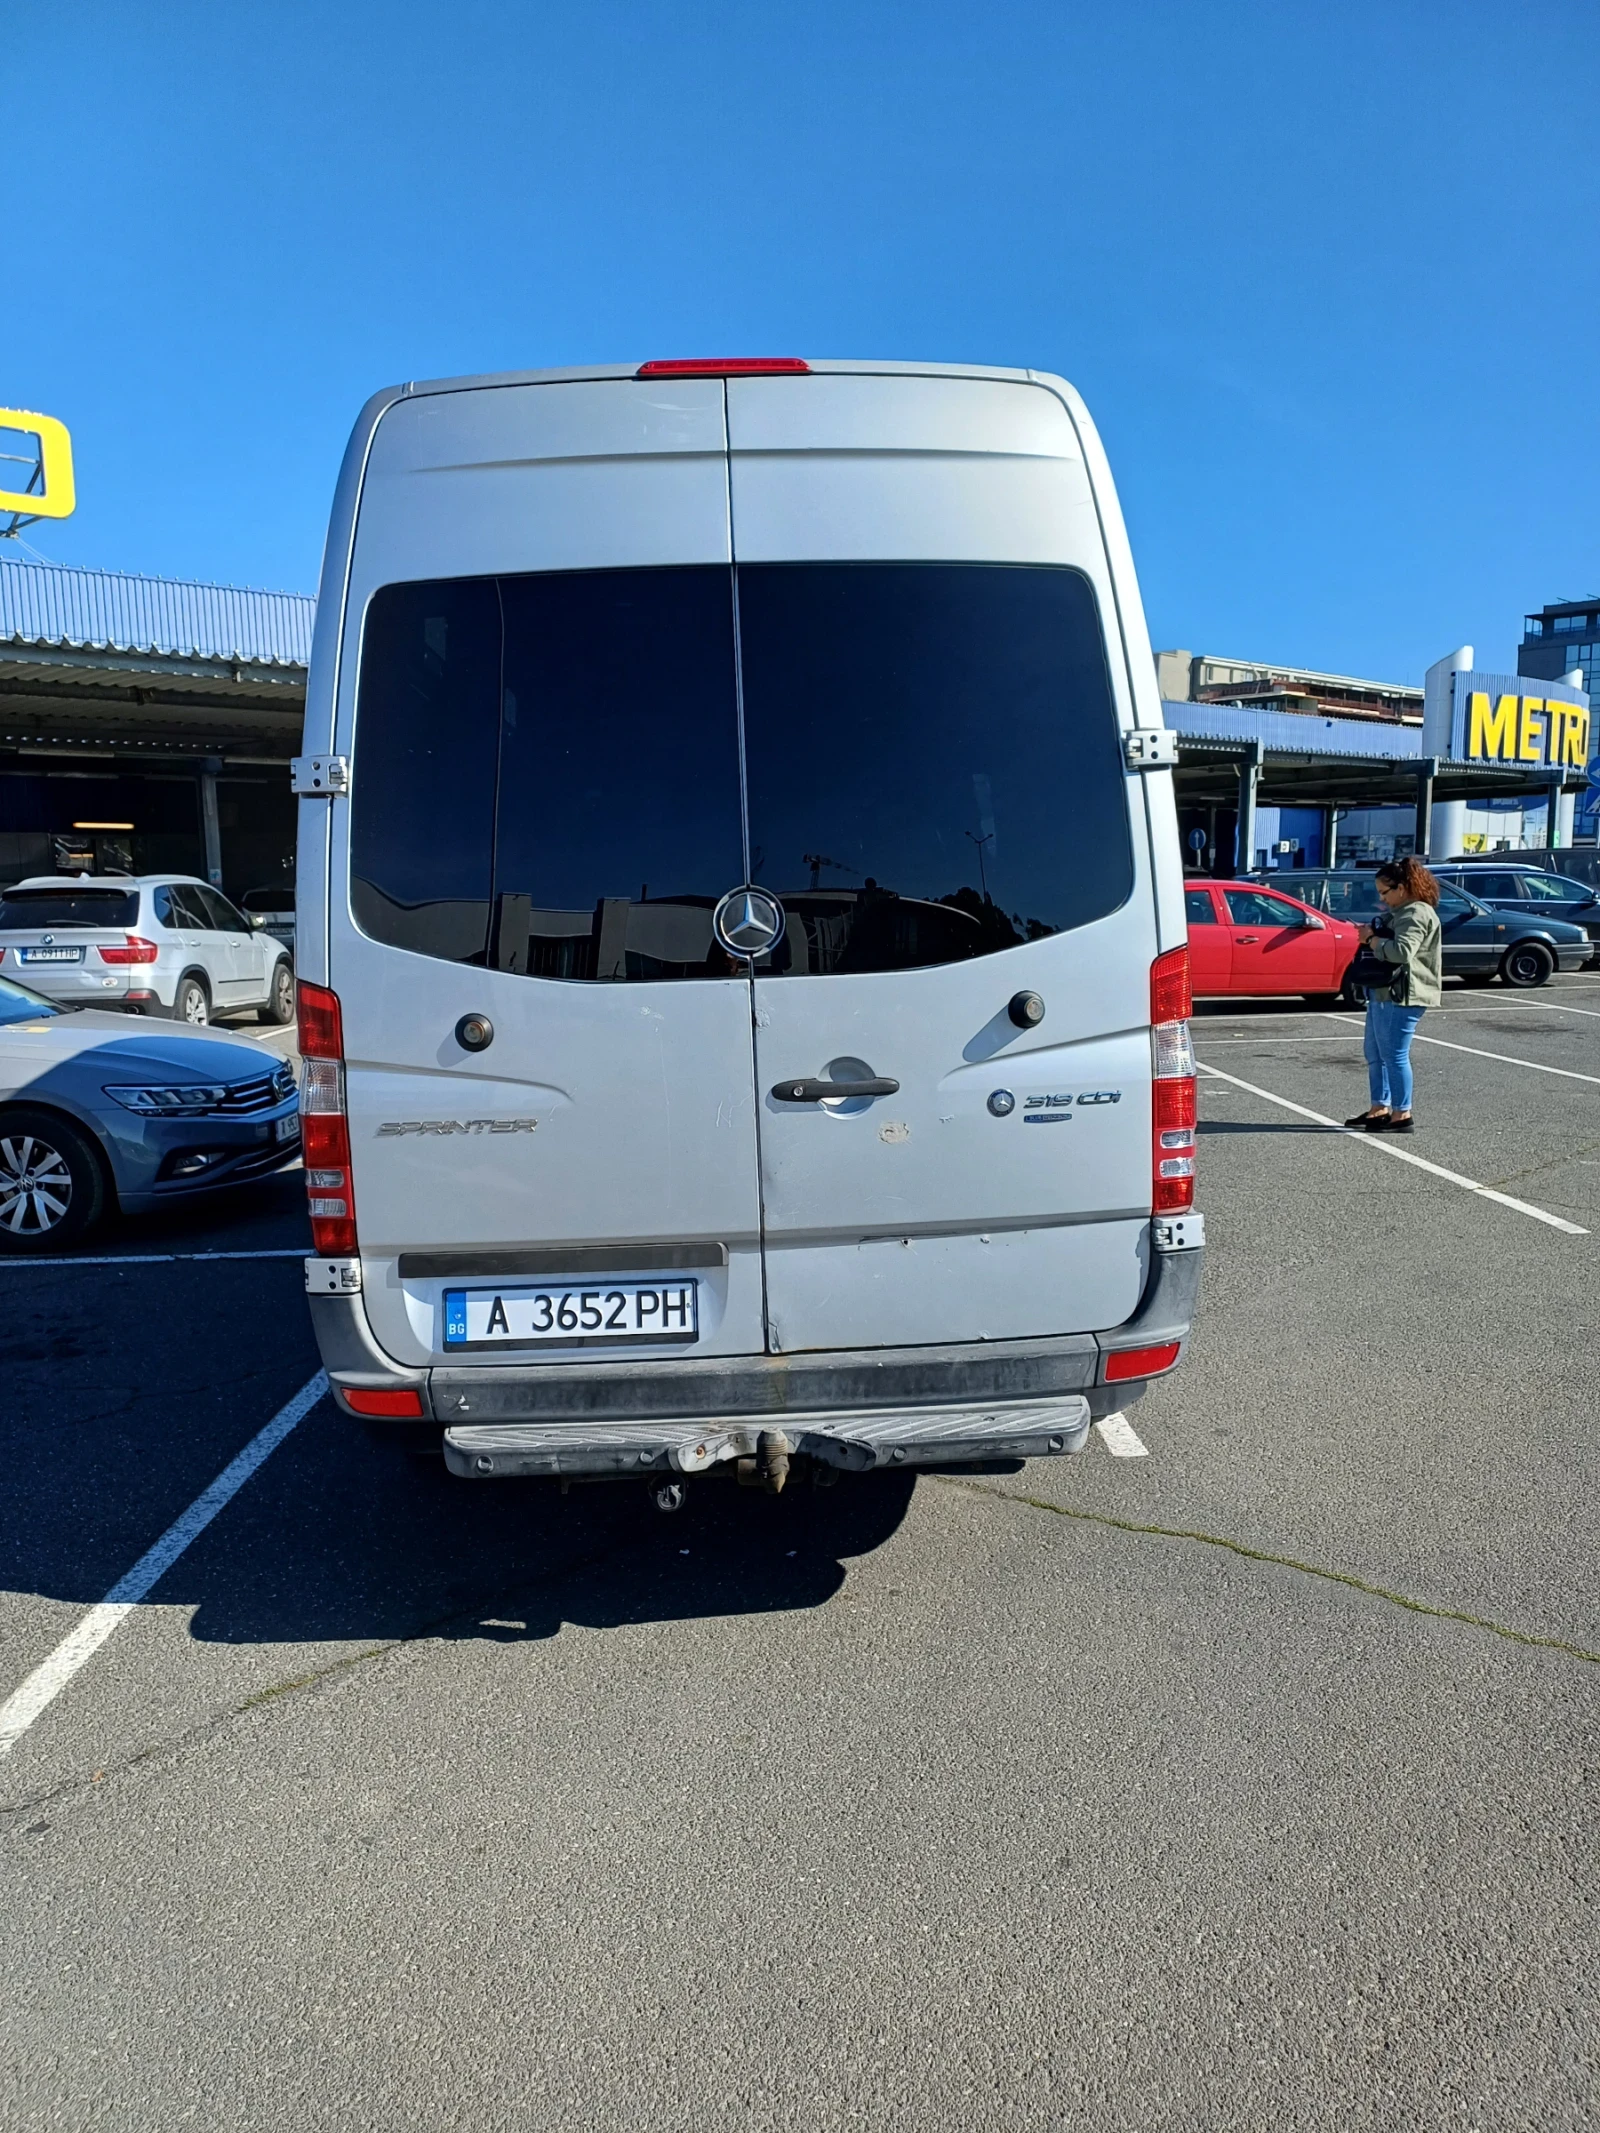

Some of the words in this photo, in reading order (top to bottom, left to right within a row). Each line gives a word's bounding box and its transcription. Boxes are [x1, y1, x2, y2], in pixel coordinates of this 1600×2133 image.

[1469, 691, 1590, 767] METRO
[375, 1118, 538, 1138] SPRINTER
[448, 1323, 465, 1335] BG
[486, 1296, 509, 1335] A
